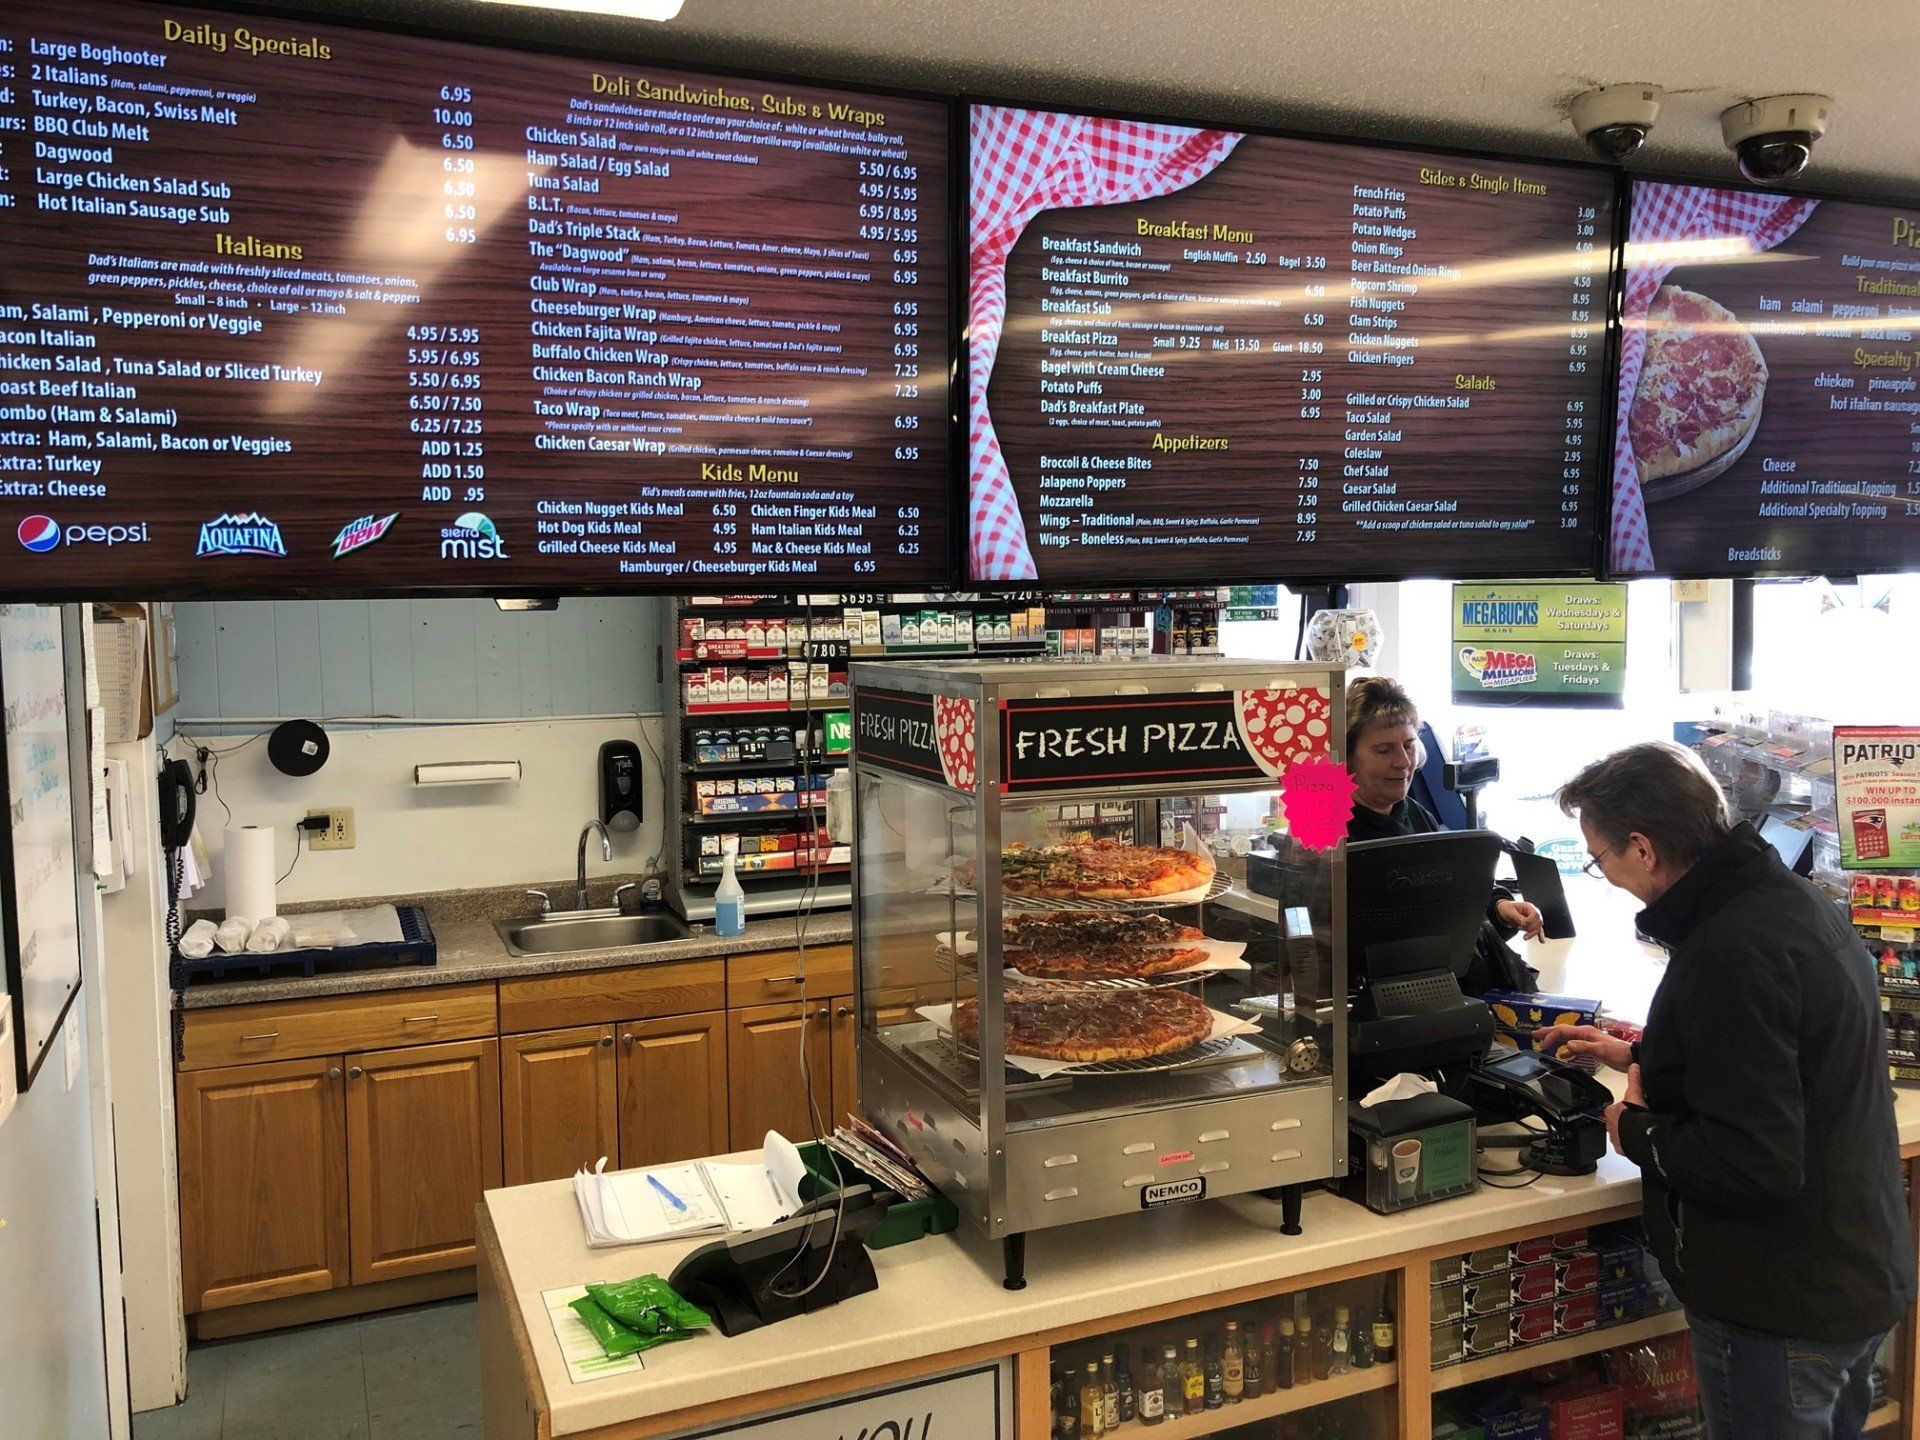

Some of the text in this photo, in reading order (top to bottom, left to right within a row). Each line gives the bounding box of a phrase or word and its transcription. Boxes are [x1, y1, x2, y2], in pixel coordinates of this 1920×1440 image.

[164, 19, 330, 58] Daily Specials
[30, 38, 166, 66] Large Boghooter
[31, 64, 108, 86] 2 Italians
[440, 85, 471, 102] 6.95
[592, 73, 884, 125] Deli Sandwiches, Subs & Wraps
[32, 89, 237, 124] Turkey, Bacon, Swiss Melt
[433, 108, 472, 126] 10.00
[35, 141, 112, 163] Dagwood
[1419, 167, 1454, 186] Sides
[1470, 172, 1509, 194] Single
[1513, 177, 1546, 195] Items
[1353, 184, 1405, 201] French Fries
[527, 195, 564, 213] B.L.T.
[1577, 206, 1595, 221] 3.00
[1137, 218, 1252, 243] Breakfast Menu
[216, 233, 302, 259] Italians
[1042, 236, 1141, 256] Breakfast Sandwich
[1183, 248, 1266, 264] English Muffin 2.50
[1279, 255, 1325, 268] Bagel 3.50
[88, 253, 116, 266] Dad’s
[118, 256, 158, 269] Italians
[160, 261, 178, 270] are
[178, 261, 209, 272] made
[210, 263, 234, 274] with
[235, 264, 271, 279] freshly
[271, 267, 300, 279] sliced
[1152, 336, 1200, 352] Small 9.25
[1212, 338, 1260, 353] Med 13.50
[1452, 374, 1495, 390] Salads
[1814, 373, 1916, 393] chicken pineapple
[1152, 433, 1228, 452] Appetizers
[1344, 446, 1382, 458] Coleslaw
[1040, 455, 1151, 469] Broccoli & Cheese Bites
[1299, 458, 1318, 470] 7.50
[1762, 458, 1795, 471] Cheese
[702, 463, 798, 482] Kids Menu
[642, 486, 854, 502] Kid’s meals come with fries, 12oz fountain soda and a toy
[1760, 480, 1896, 498] Additional Traditional Topping
[1039, 494, 1093, 506] Mozzarella
[66, 522, 148, 546] pepsi
[196, 523, 288, 557] AQUAFINA
[441, 528, 480, 538] sierra
[441, 535, 509, 558] mist
[1728, 546, 1781, 560] Breadsticks
[1565, 594, 1601, 604] Draws:
[1462, 602, 1538, 625] MEGABUCKS
[1546, 608, 1621, 619] Wednesdays &
[1557, 620, 1608, 631] Saturdays
[1485, 650, 1534, 670] MEGA
[1564, 650, 1600, 659] Draws:
[1482, 668, 1534, 680] MILLIONS
[1553, 662, 1610, 674] Tuesdays &
[1493, 676, 1534, 686] MEGAPLIER
[1563, 674, 1600, 686] Fridays
[860, 712, 895, 741] FRESH
[900, 718, 938, 754] PIZZA
[1015, 720, 1240, 759] FRESH PIZZA
[1294, 773, 1335, 792] Pizza
[1866, 786, 1916, 794] WIN UP TO
[1884, 978, 1920, 986] EXTRA
[1149, 1182, 1198, 1199] NEMCO
